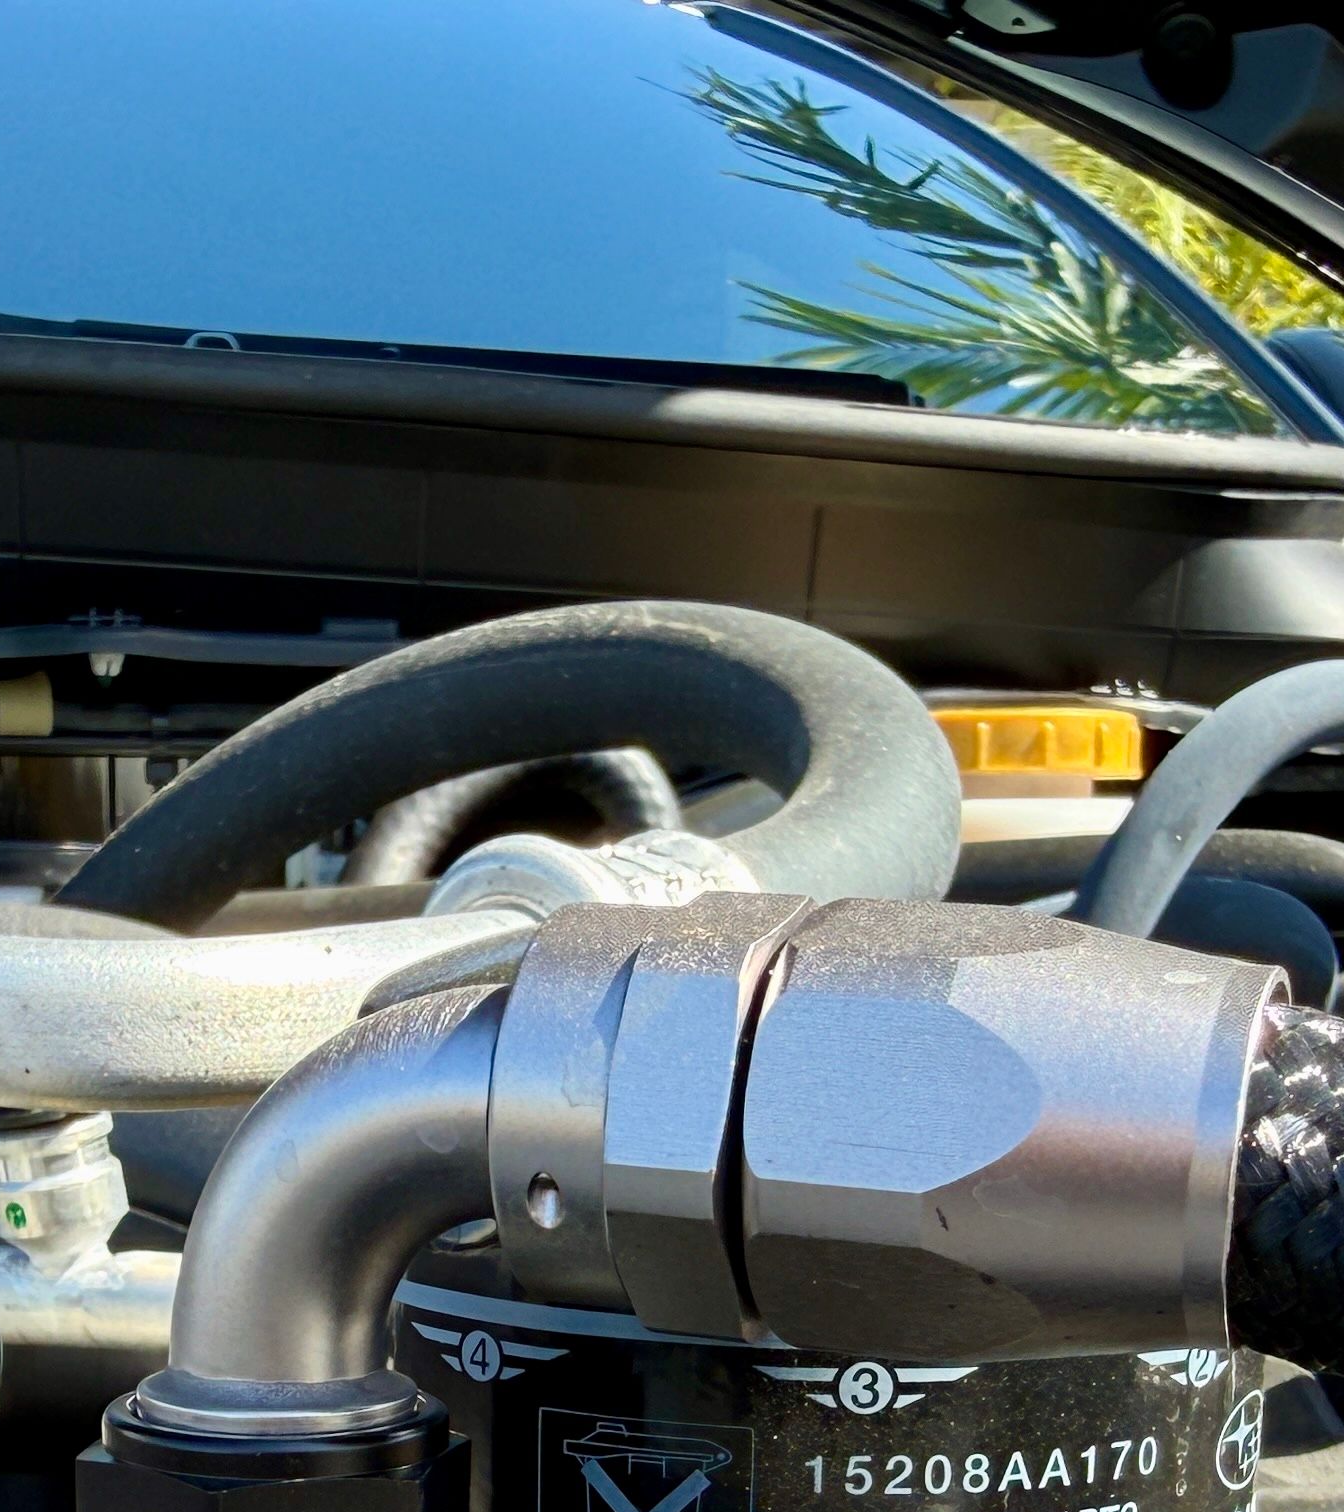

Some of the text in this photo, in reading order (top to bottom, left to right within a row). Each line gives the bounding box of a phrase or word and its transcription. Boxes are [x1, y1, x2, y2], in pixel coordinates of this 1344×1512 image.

[469, 1337, 490, 1376] 4
[850, 1367, 881, 1409] 3
[804, 1436, 1158, 1496] 15208AA170
